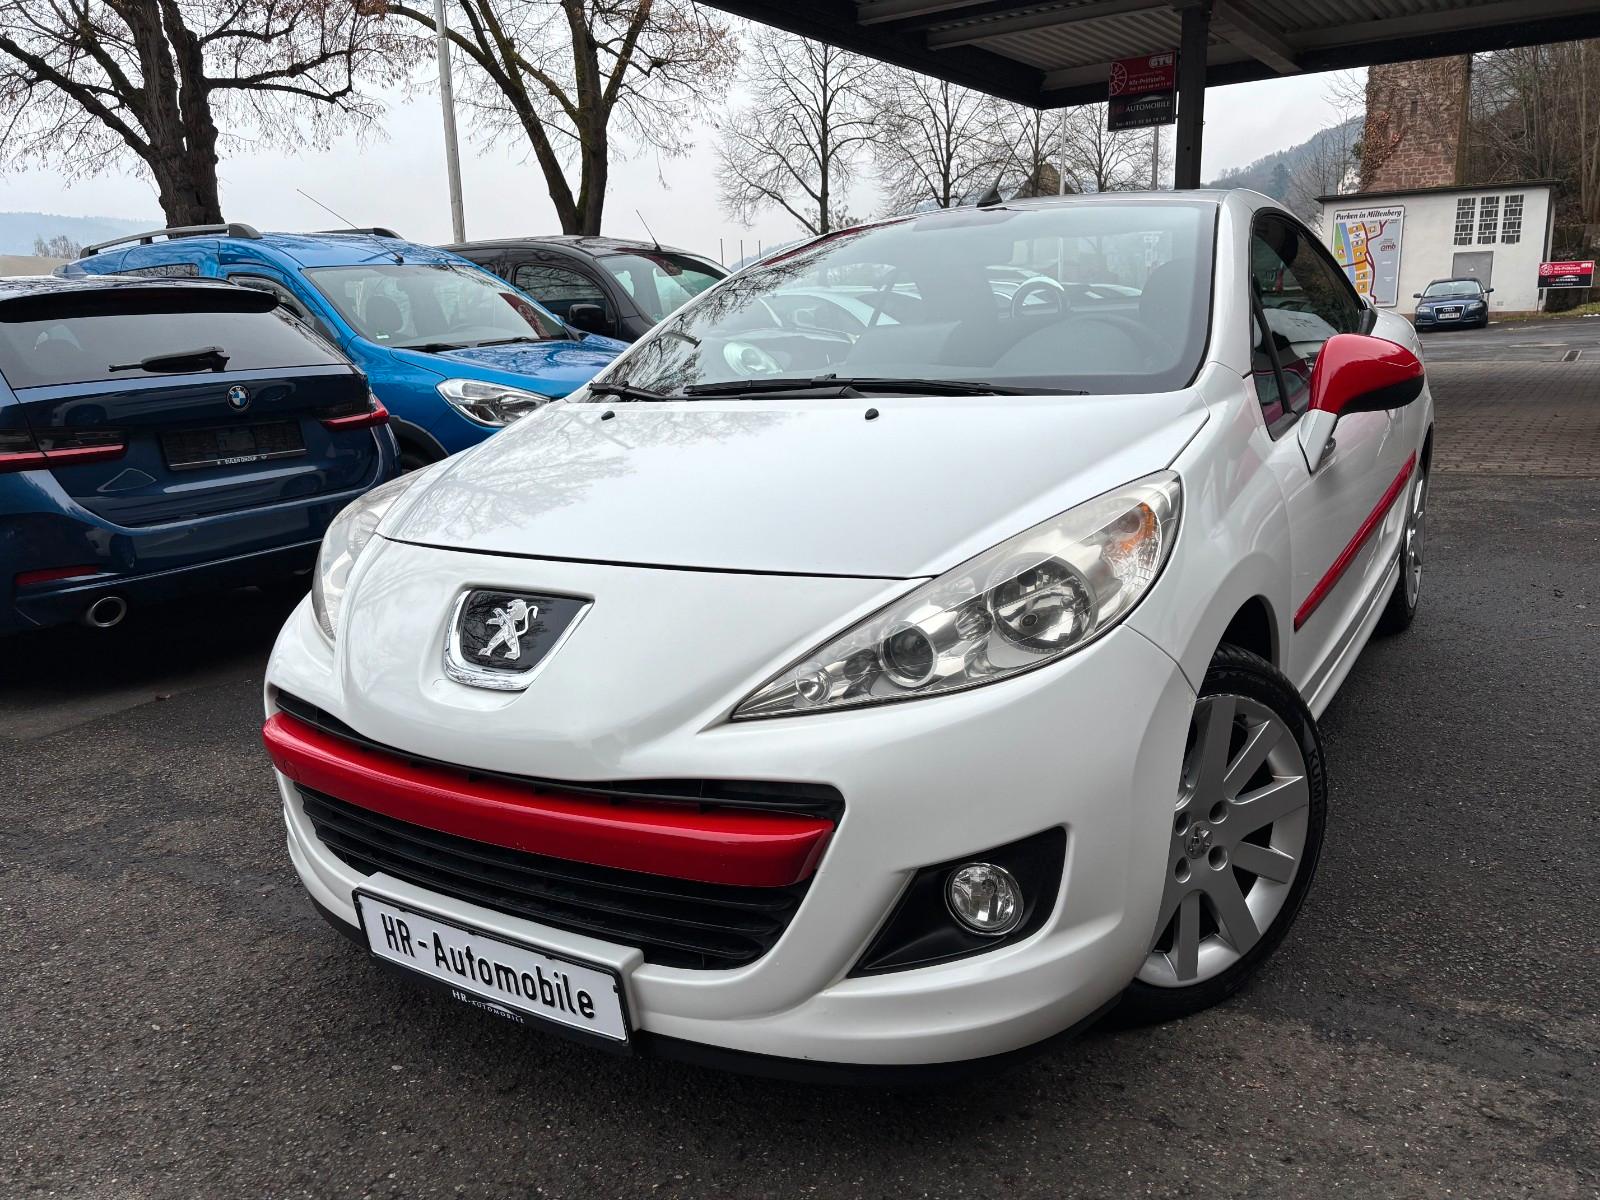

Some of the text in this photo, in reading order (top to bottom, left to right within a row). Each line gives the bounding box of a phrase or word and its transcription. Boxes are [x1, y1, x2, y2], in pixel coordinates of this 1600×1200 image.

[1127, 101, 1170, 112] AUTOMOBILE
[1336, 212, 1359, 220] Parken
[1366, 209, 1402, 218] Miltenberg
